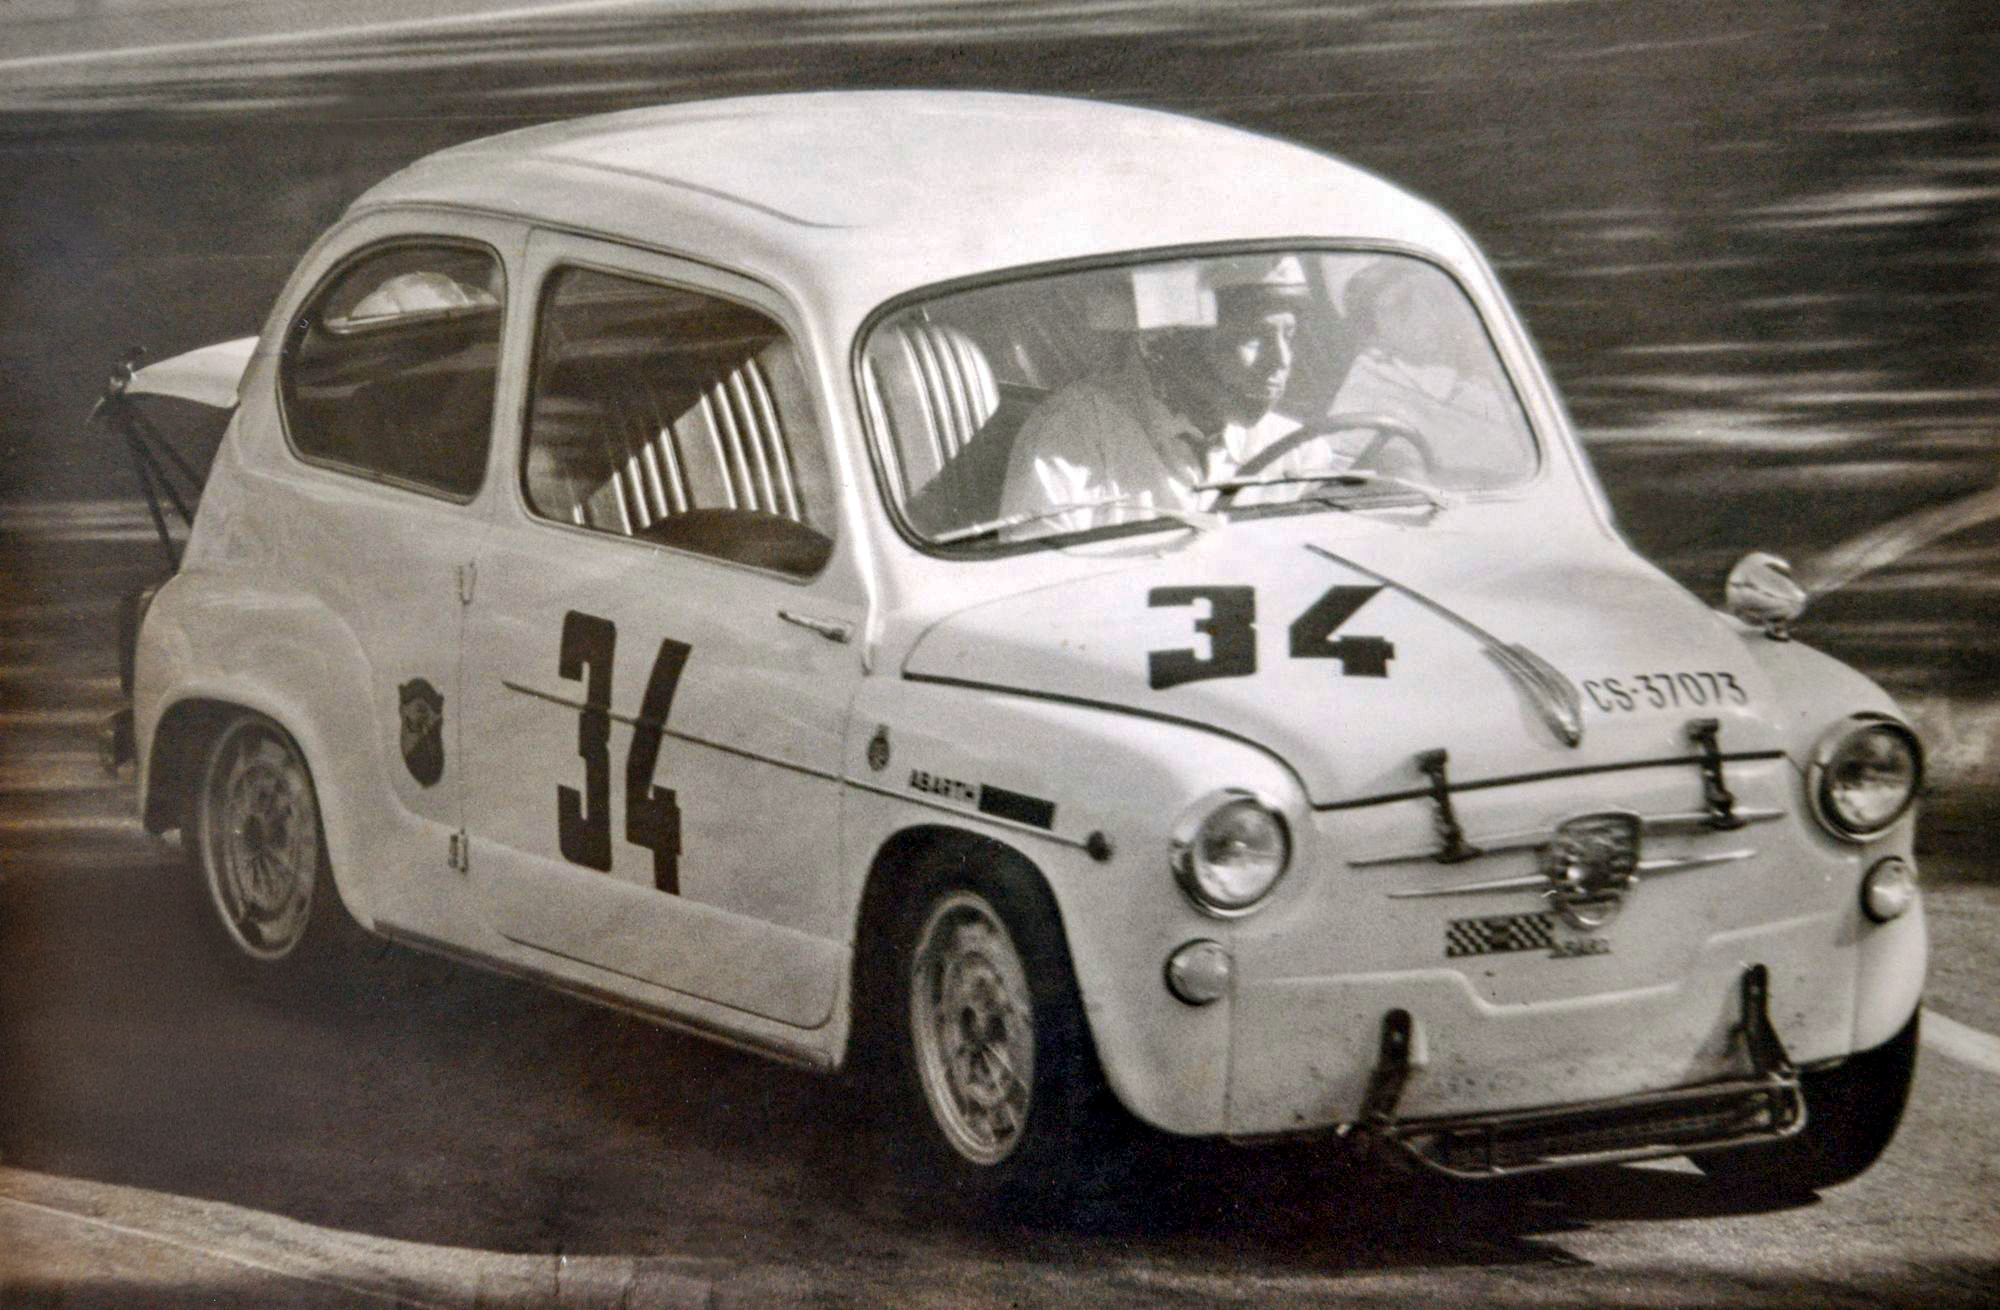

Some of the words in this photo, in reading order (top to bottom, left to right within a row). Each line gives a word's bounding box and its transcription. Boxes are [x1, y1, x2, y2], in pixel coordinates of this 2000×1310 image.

[1147, 585, 1394, 690] 34
[1583, 671, 1748, 712] CS-37073
[558, 609, 693, 896] 34
[909, 769, 977, 800] ABARTH
